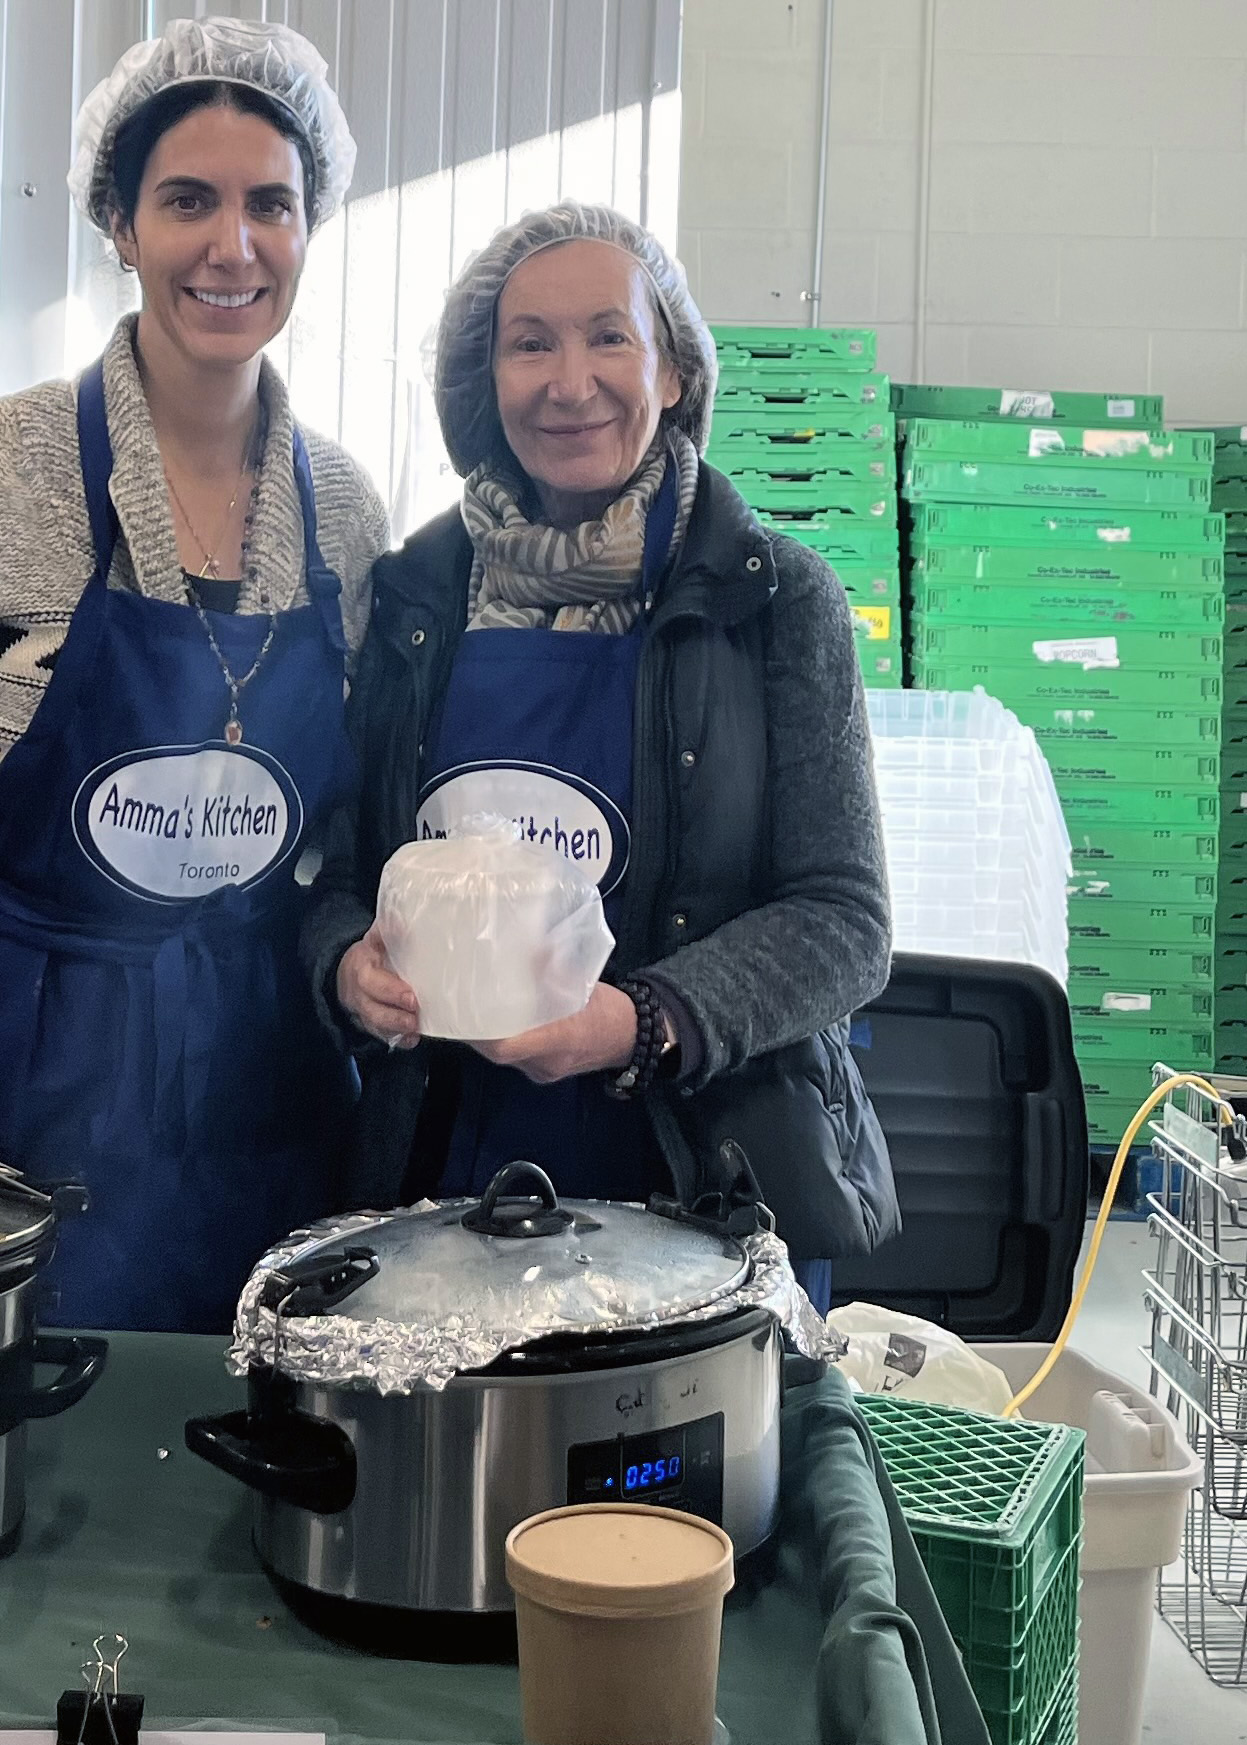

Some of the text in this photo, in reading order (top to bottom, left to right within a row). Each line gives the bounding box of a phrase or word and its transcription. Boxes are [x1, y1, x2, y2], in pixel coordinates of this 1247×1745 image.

[99, 782, 277, 839] Amma's Kitchen
[512, 815, 601, 860] itchen
[178, 861, 240, 880] Toronto
[625, 1456, 680, 1490] 0250
